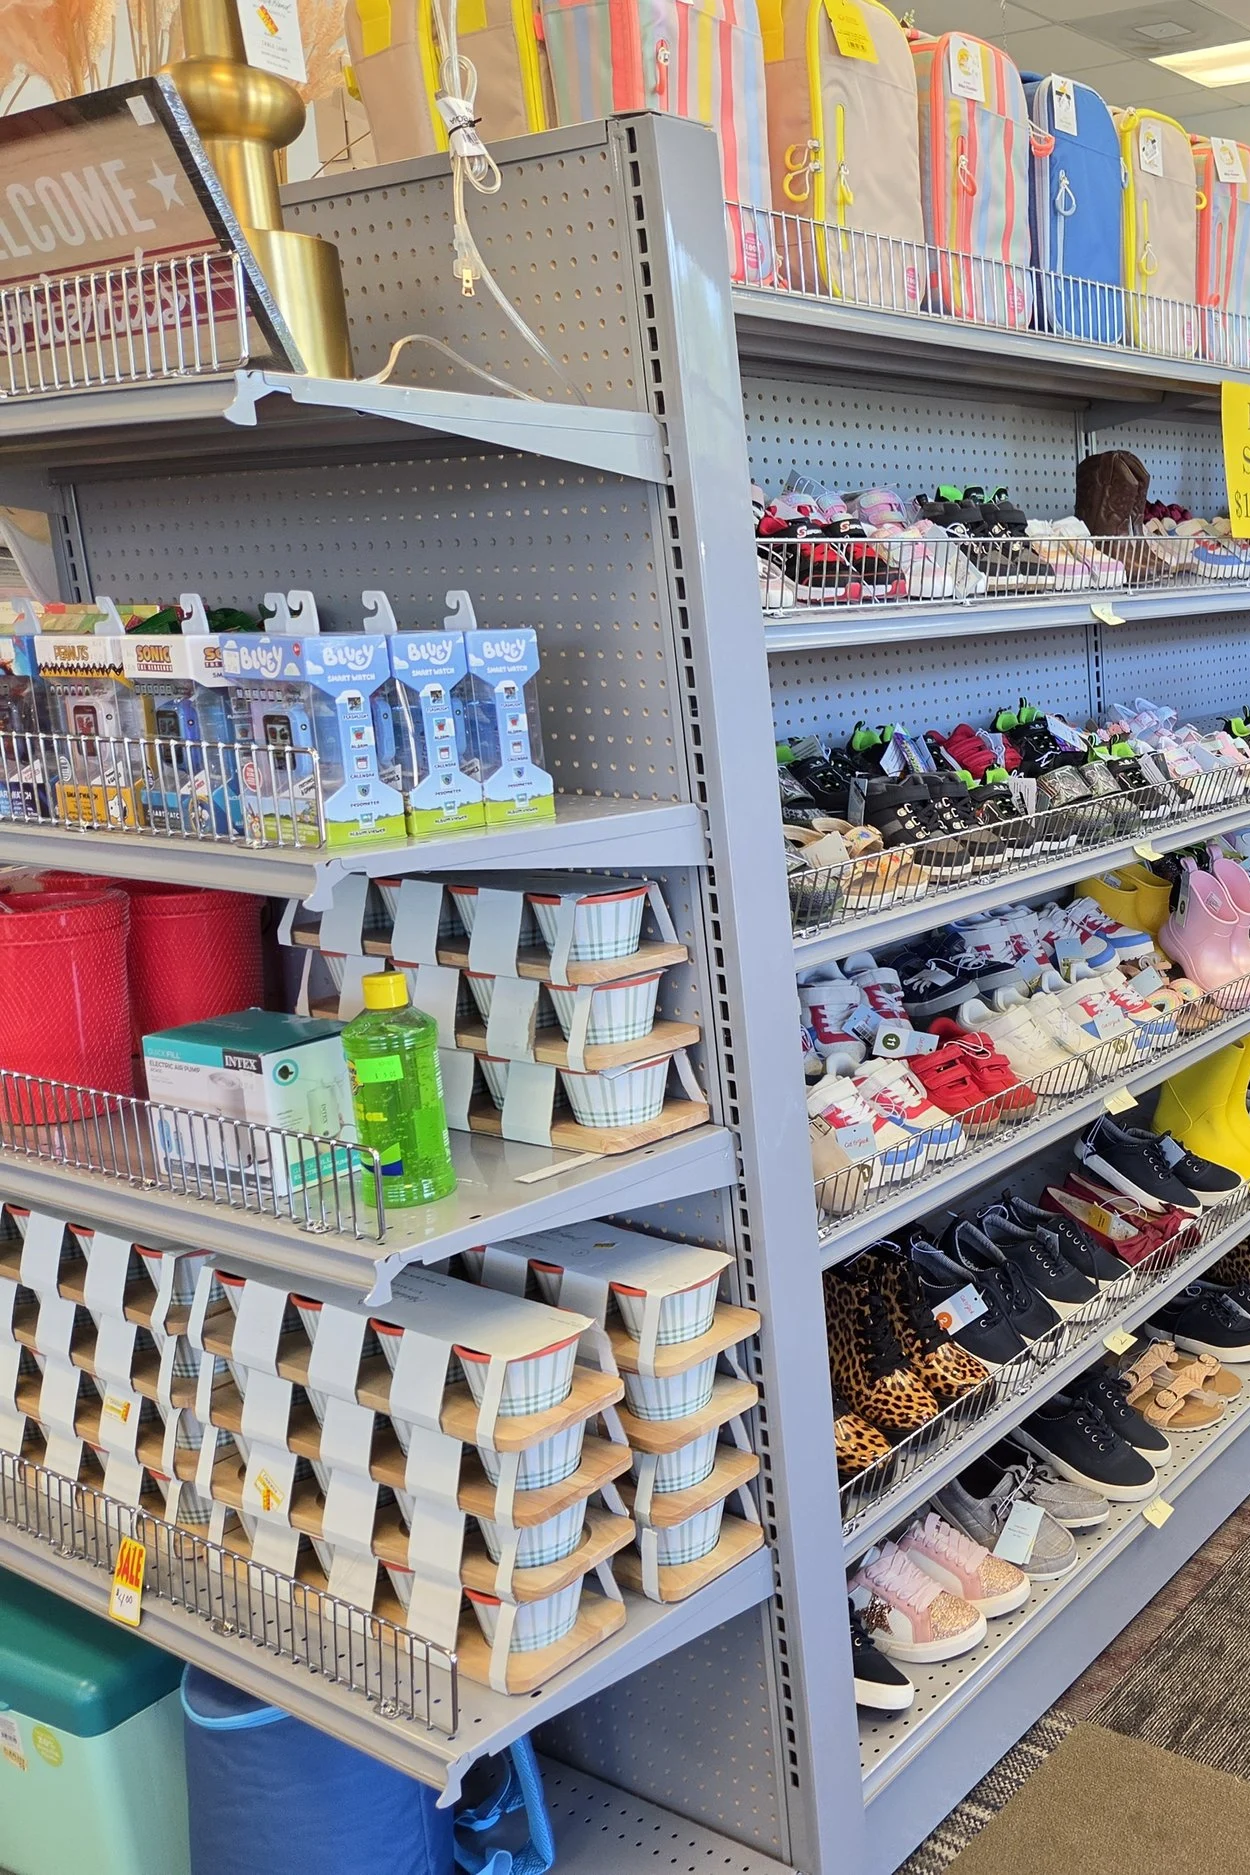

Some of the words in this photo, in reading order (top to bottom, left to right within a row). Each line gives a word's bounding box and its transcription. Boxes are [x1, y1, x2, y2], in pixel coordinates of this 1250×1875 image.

[0, 158, 157, 260] LCOME
[53, 644, 89, 662] PEANUTS
[135, 644, 172, 664] SONIC
[411, 669, 433, 677] SMART
[433, 667, 455, 675] WATCH
[486, 666, 508, 674] SMART
[508, 664, 528, 673] WATCH
[327, 674, 351, 683] SMART
[352, 673, 376, 682] WATCH
[886, 1036, 898, 1047] 11
[224, 1055, 257, 1070] INTEX
[116, 1541, 144, 1589] SALE
